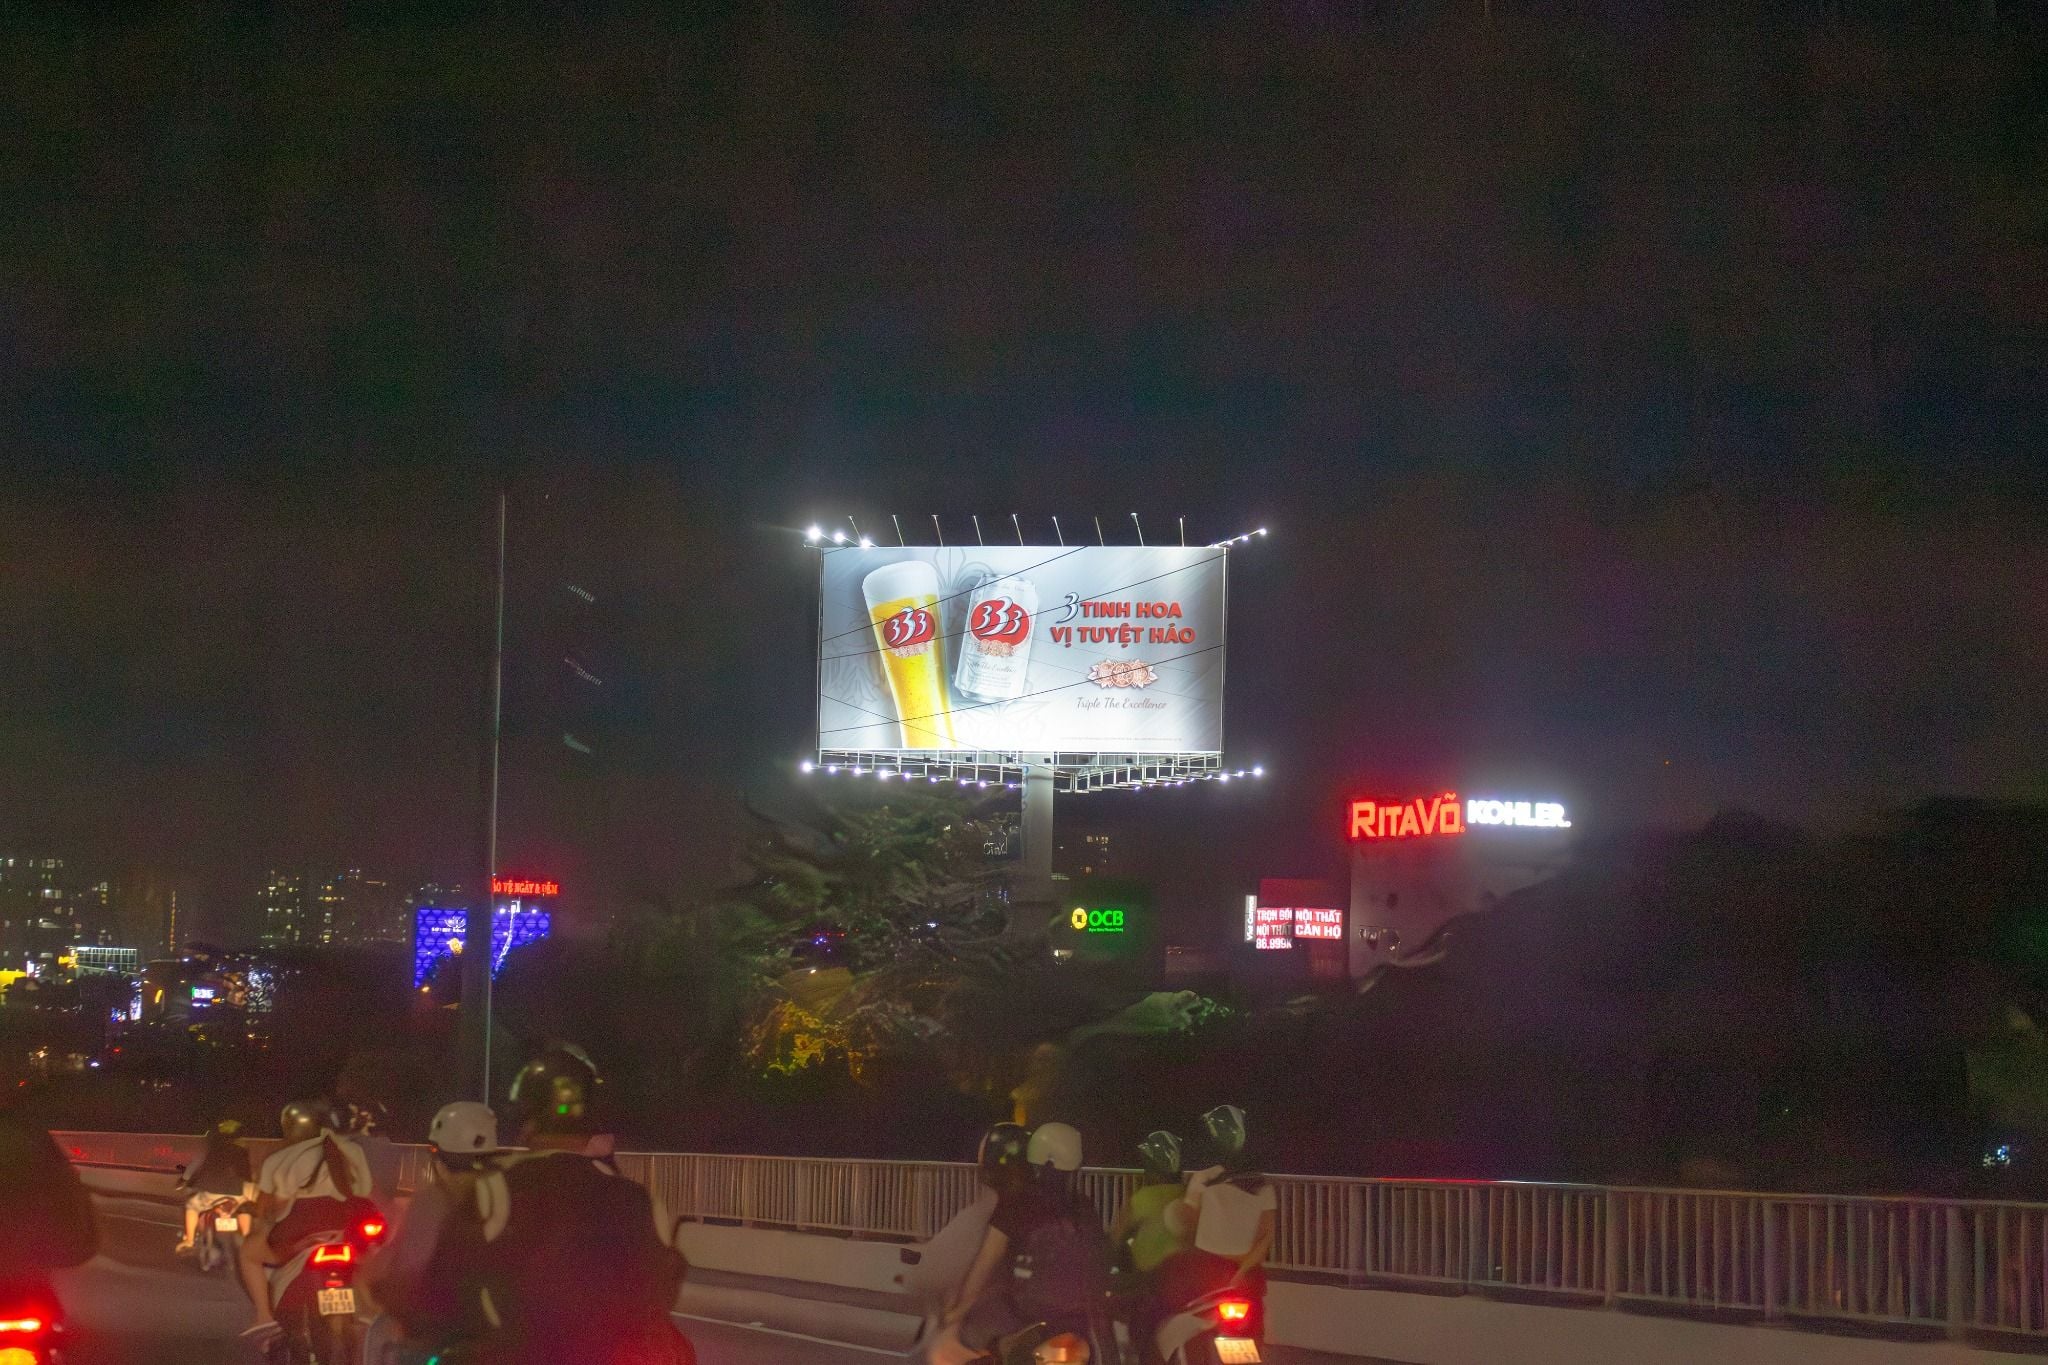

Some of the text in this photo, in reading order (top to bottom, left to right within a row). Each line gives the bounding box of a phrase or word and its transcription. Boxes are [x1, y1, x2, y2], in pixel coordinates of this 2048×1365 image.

[974, 595, 1023, 637] 333
[1055, 592, 1183, 624] 3 TINH HOA
[888, 605, 928, 646] 333
[1050, 622, 1197, 648] VỊ TUYỆT HẢO
[1076, 696, 1168, 712] Triple The Excellence
[1089, 910, 1123, 926] OCB
[1296, 908, 1341, 923] NỘI THẤT
[1324, 925, 1341, 939] HỘ
